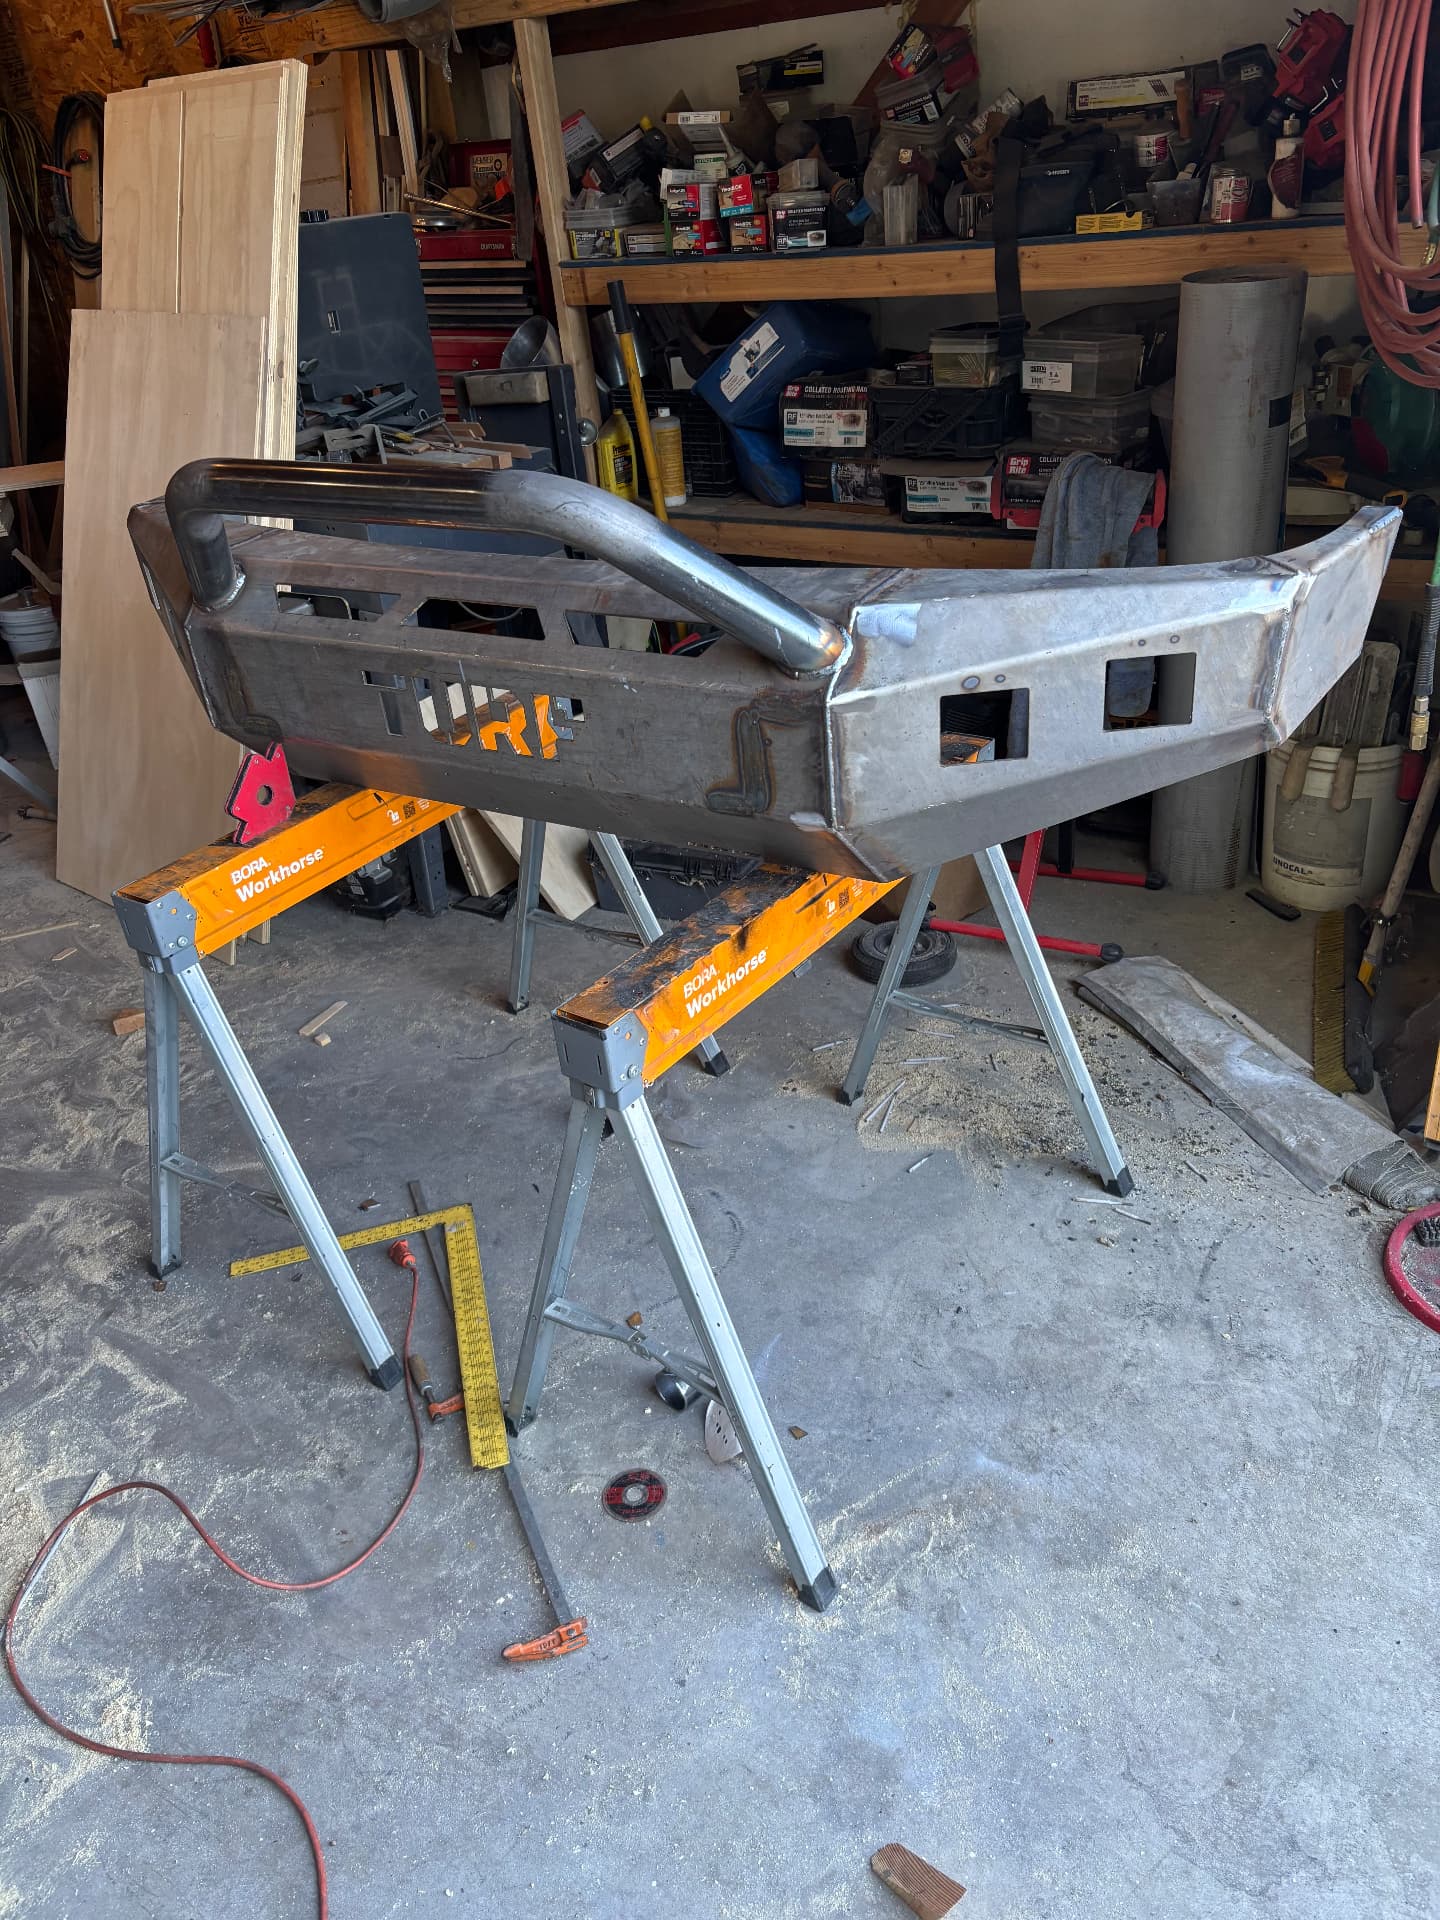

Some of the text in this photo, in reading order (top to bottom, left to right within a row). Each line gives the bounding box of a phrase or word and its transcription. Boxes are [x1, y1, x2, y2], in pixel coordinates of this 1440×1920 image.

[1010, 458, 1029, 467] Grip
[230, 856, 269, 886] BORA
[235, 848, 324, 904] Workhorse
[1272, 856, 1305, 875] UNOCAL
[683, 963, 718, 999] BORA
[686, 949, 767, 1019] Workhorse
